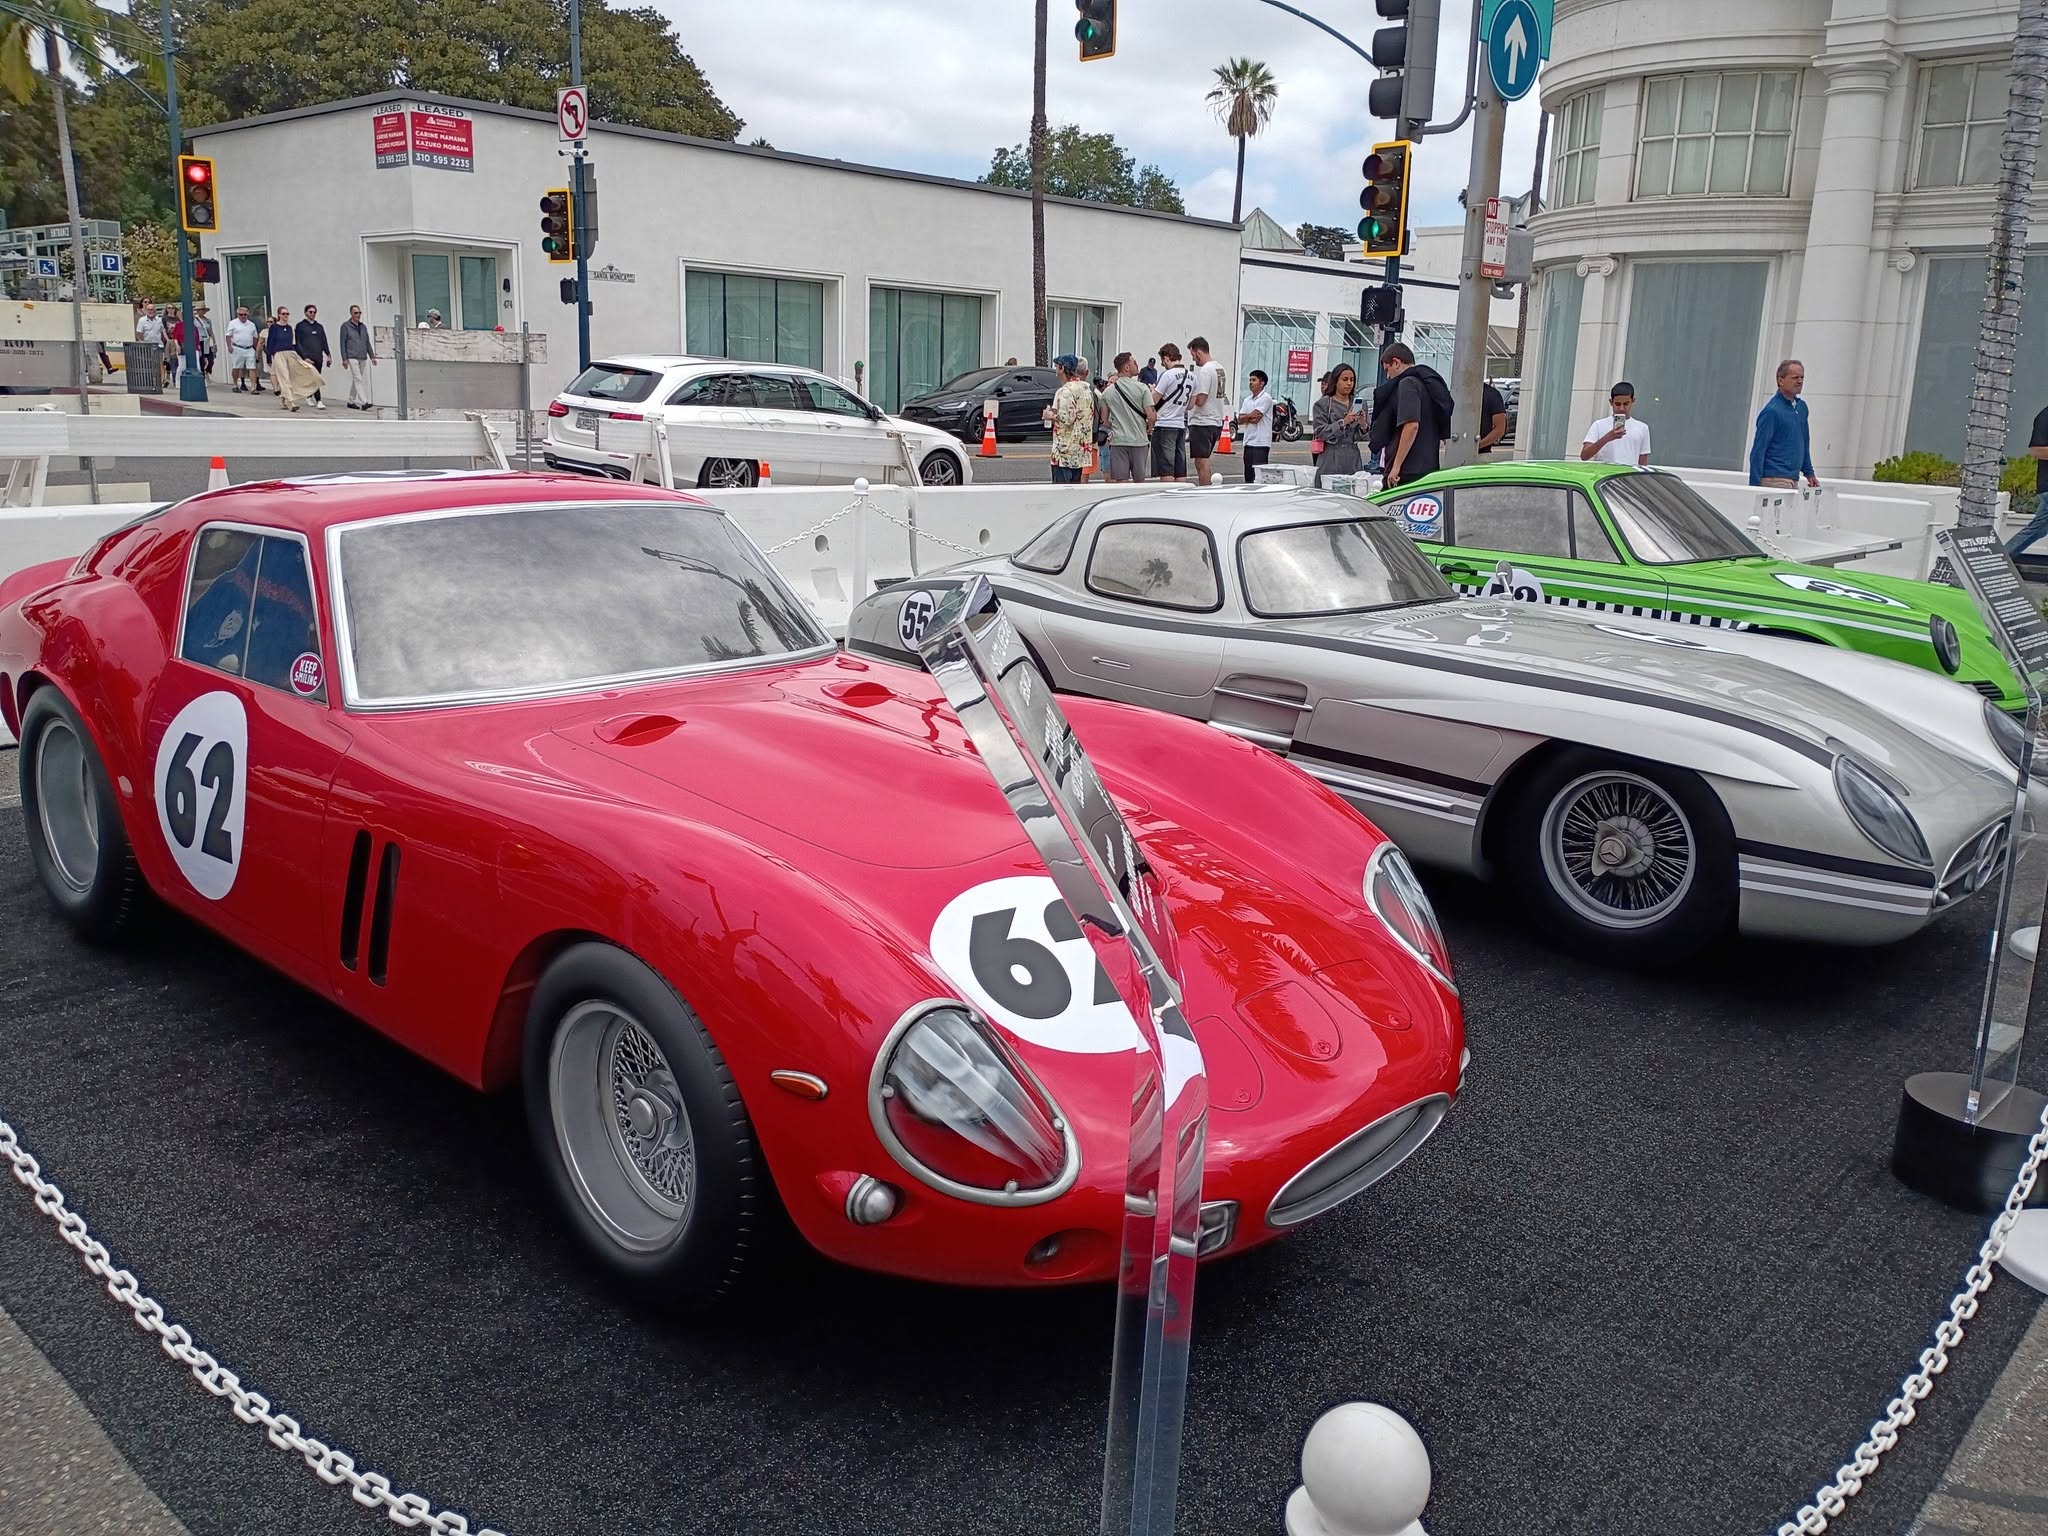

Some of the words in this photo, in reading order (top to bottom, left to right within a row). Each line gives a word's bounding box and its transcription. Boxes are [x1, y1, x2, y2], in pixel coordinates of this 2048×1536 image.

[376, 104, 402, 115] LEASED
[417, 104, 464, 118] LEASED
[415, 130, 438, 139] CARINE
[440, 134, 466, 143] MAMANN
[415, 140, 441, 148] KAZUKO
[443, 144, 469, 153] MORGAN
[415, 153, 430, 162] 310
[433, 156, 448, 165] 595
[450, 158, 470, 168] 2235
[1487, 201, 1497, 217] NO
[1486, 221, 1508, 236] STOPPING
[1486, 236, 1495, 246] ANY
[1496, 237, 1505, 248] TIME
[105, 256, 115, 269] P
[376, 294, 392, 304] 474
[1173, 384, 1192, 406] 23
[1409, 503, 1437, 516] LIFE
[902, 600, 931, 641] 55
[299, 660, 318, 674] KEEP
[294, 671, 318, 686] SMILING
[165, 732, 234, 864] 62
